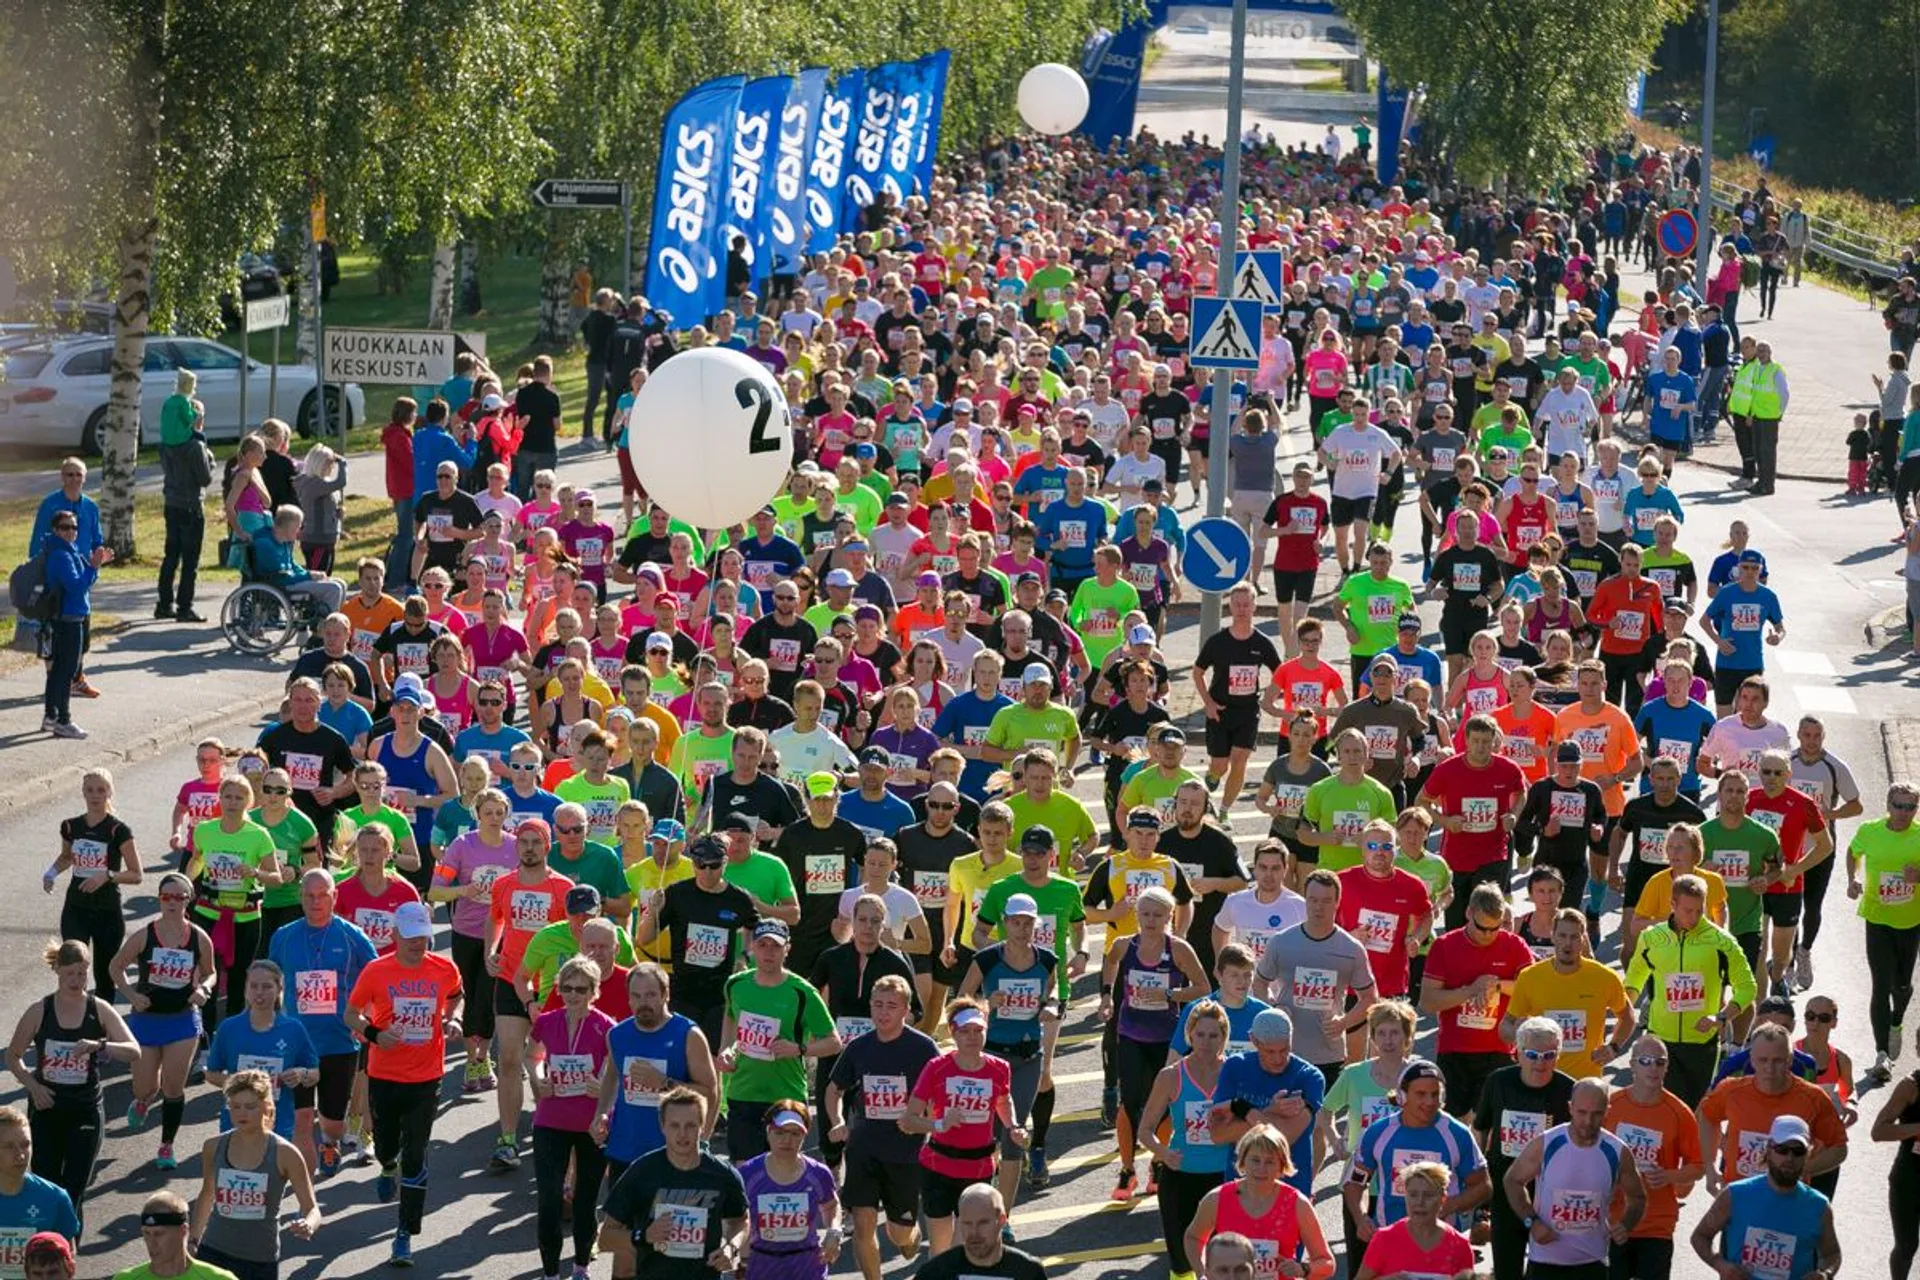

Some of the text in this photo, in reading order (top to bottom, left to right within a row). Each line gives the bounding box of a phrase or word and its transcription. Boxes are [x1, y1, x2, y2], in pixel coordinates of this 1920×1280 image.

[810, 95, 850, 188] asics
[777, 104, 806, 201] asics
[727, 110, 768, 221] asics
[667, 125, 715, 242] asics
[331, 336, 444, 356] KUOKKALAN
[331, 359, 428, 378] KESKUSTA
[735, 378, 781, 454] 2
[294, 760, 315, 768] YIT
[1463, 812, 1496, 823] 1512
[808, 870, 843, 883] 2266
[513, 907, 549, 921] 1568
[364, 917, 389, 925] YIT
[1367, 918, 1391, 927] YIT
[697, 932, 720, 942] YIT
[689, 940, 727, 957] 2089
[161, 957, 186, 967] YIT
[304, 979, 330, 988] YIT
[1137, 979, 1161, 987] YIT
[1304, 976, 1329, 984] YIT
[1674, 979, 1697, 988] YIT
[298, 987, 336, 1001] 2301
[388, 979, 439, 999] ASICS
[1008, 987, 1033, 995] YIT
[1296, 986, 1332, 999] 1734
[403, 1006, 430, 1016] YIT
[395, 1014, 432, 1027] 2290
[746, 1021, 773, 1035] YIT
[845, 1026, 871, 1034] YIT
[44, 1057, 88, 1071] 2258
[560, 1064, 585, 1072] YIT
[956, 1086, 985, 1096] YIT
[865, 1092, 907, 1107] 1412
[949, 1095, 990, 1111] 1575
[1510, 1120, 1536, 1129] YIT
[1624, 1134, 1653, 1145] YIT
[228, 1180, 257, 1190] YIT
[220, 1188, 265, 1206] 1969
[769, 1203, 799, 1213] YIT
[1563, 1199, 1592, 1209] YIT
[1554, 1205, 1598, 1221] 2182
[673, 1216, 698, 1227] IT
[760, 1212, 808, 1228] 1576
[1755, 1237, 1786, 1252] YIT
[1745, 1246, 1791, 1269] 1996
